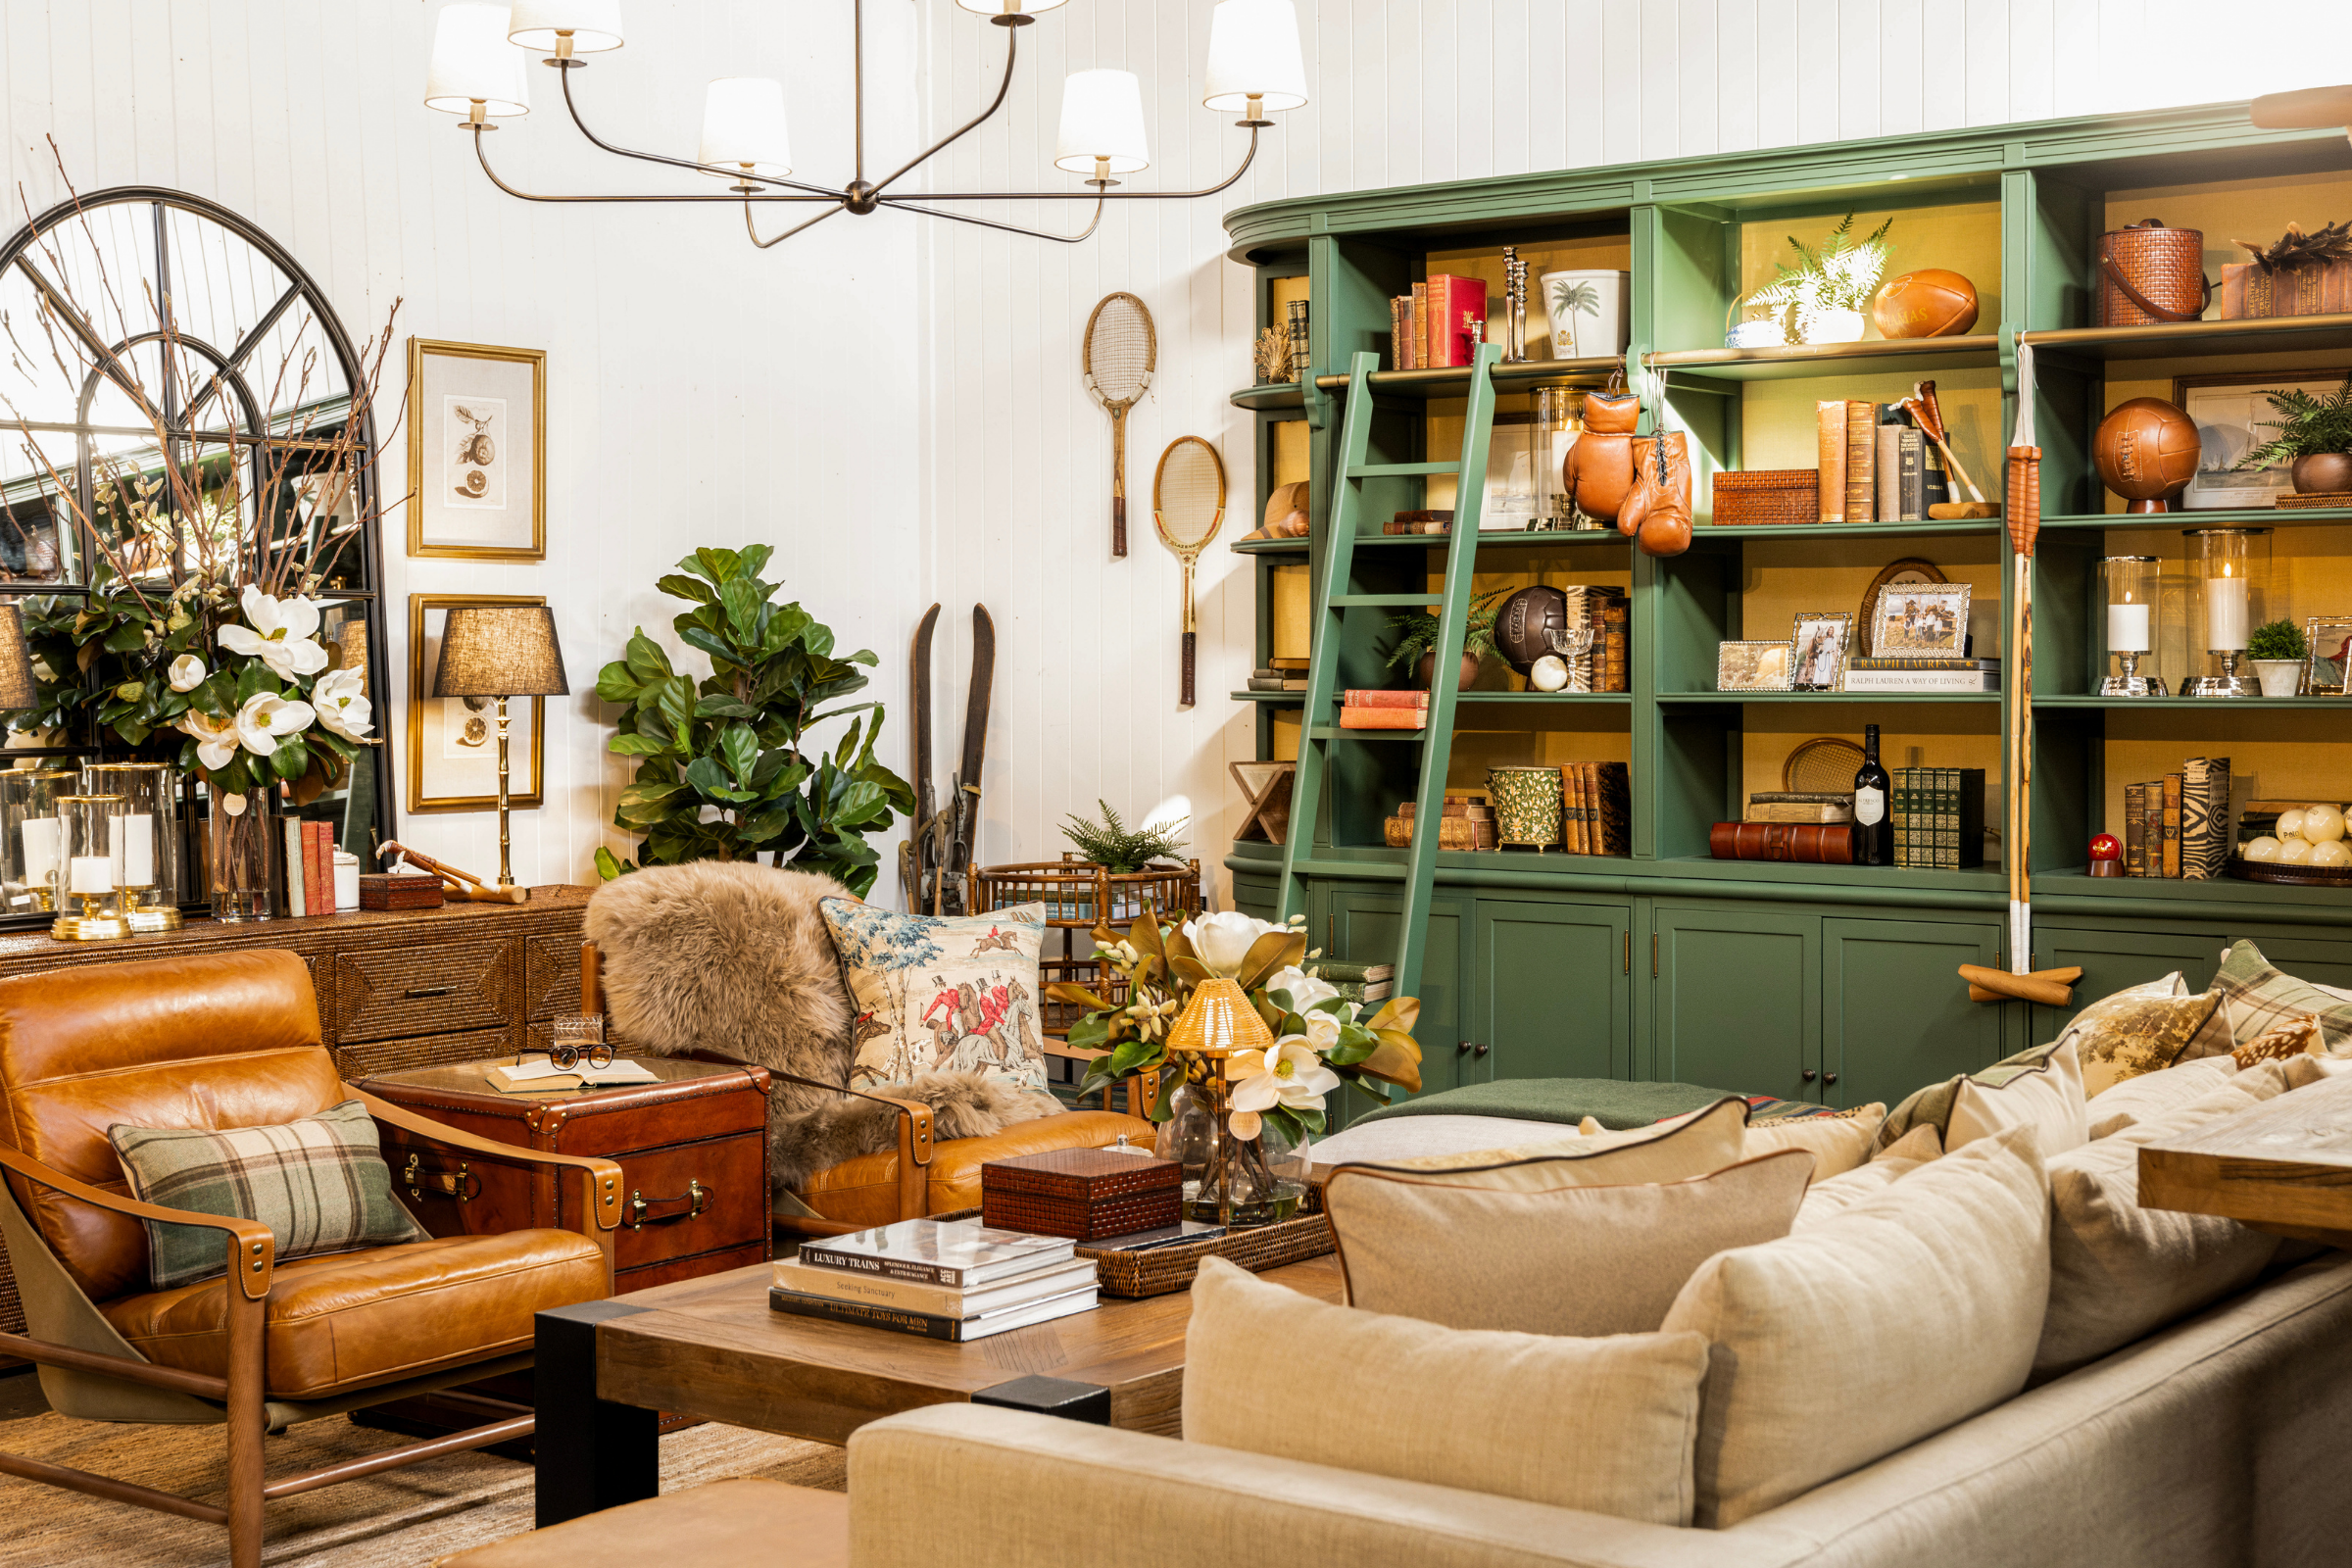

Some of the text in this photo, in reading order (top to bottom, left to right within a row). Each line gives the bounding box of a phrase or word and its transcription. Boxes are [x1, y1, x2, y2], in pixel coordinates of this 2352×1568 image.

[1861, 659, 1950, 668] RALPH LAUREN
[813, 1252, 848, 1266] LUXURY
[848, 1256, 880, 1271] TRAINS
[836, 1281, 896, 1299] Seeking Sanctuary
[830, 1302, 928, 1328] ULTIMATE TOYS FOR MEN
